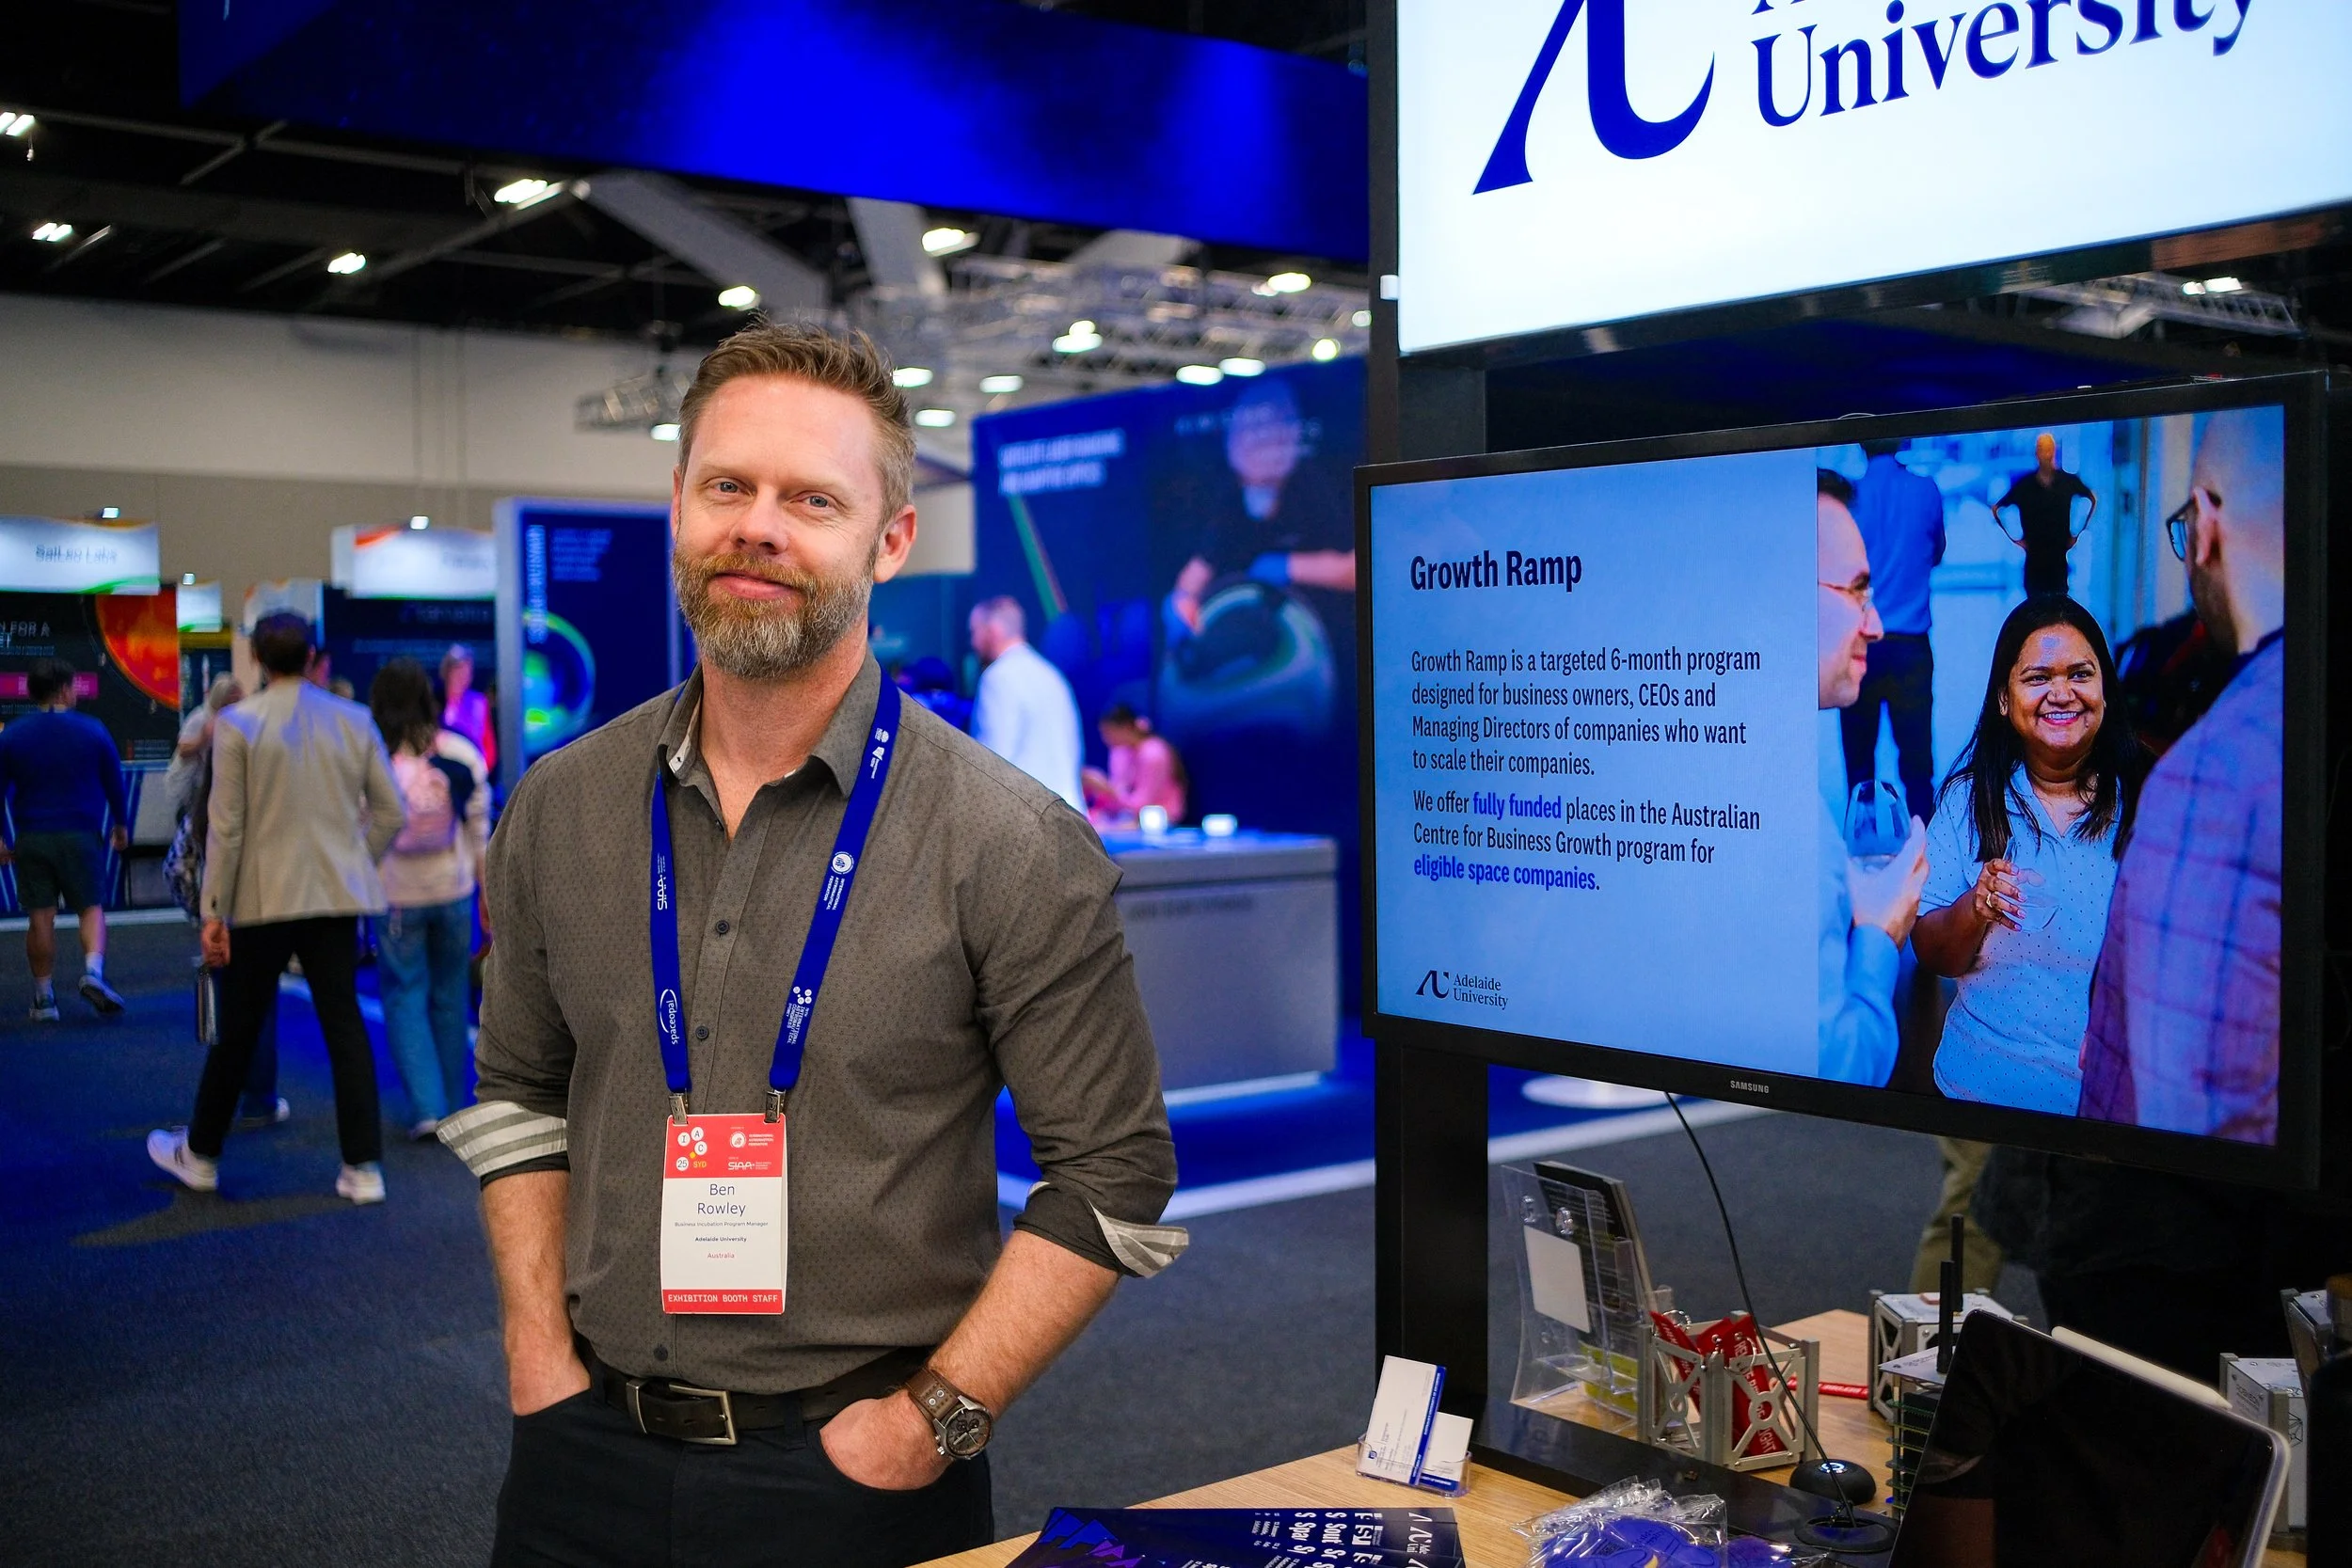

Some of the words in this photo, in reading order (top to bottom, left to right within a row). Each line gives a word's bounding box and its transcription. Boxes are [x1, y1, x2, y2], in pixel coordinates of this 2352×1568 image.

[1411, 550, 1498, 590] Growth
[1506, 551, 1582, 592] Ramp
[1412, 649, 1461, 672] Growth
[1466, 650, 1506, 675] Ramp
[1511, 648, 1523, 672] is
[1528, 654, 1536, 672] a
[1540, 647, 1606, 676] targeted
[1611, 646, 1681, 671] 6-month
[1687, 650, 1760, 675] program
[1412, 682, 1474, 709] designed
[1479, 683, 1498, 705] for
[1503, 683, 1568, 705] business
[1573, 686, 1634, 709] owners,
[1639, 684, 1679, 707] CEOs
[1685, 683, 1715, 707] and
[1413, 716, 1479, 741] Managing
[1483, 717, 1549, 739] Directors
[1555, 718, 1570, 740] of
[1574, 718, 1659, 745] companies
[1665, 719, 1699, 742] who
[1704, 722, 1746, 744] want
[1413, 752, 1426, 770] to
[1431, 749, 1466, 771] scale
[1471, 749, 1504, 772] their
[1509, 752, 1594, 778] companies.
[1414, 790, 1433, 812] We
[1437, 791, 1469, 814] offer
[1473, 792, 1505, 820] fully
[1510, 793, 1561, 818] funded
[1567, 797, 1616, 824] places
[1621, 800, 1634, 823] in
[1641, 802, 1667, 824] the
[1672, 803, 1760, 829] Australian
[1414, 824, 1459, 845] Centre
[1463, 824, 1482, 847] for
[1487, 827, 1551, 852] Business
[1556, 831, 1611, 857] Growth
[1617, 838, 1685, 863] program
[1692, 838, 1714, 863] for
[1414, 854, 1464, 882] eligible
[1468, 862, 1509, 885] space
[1514, 863, 1600, 891] companies.
[1454, 973, 1501, 991] Adelaide
[1453, 988, 1509, 1010] University
[1730, 1080, 1769, 1093] SAMSUNG
[677, 1159, 688, 1168] 25
[709, 1183, 735, 1196] Ben
[697, 1202, 746, 1217] Rowley
[668, 1294, 718, 1302] EXHIBITION
[723, 1294, 748, 1302] BOOTH
[752, 1294, 778, 1302] STAFF
